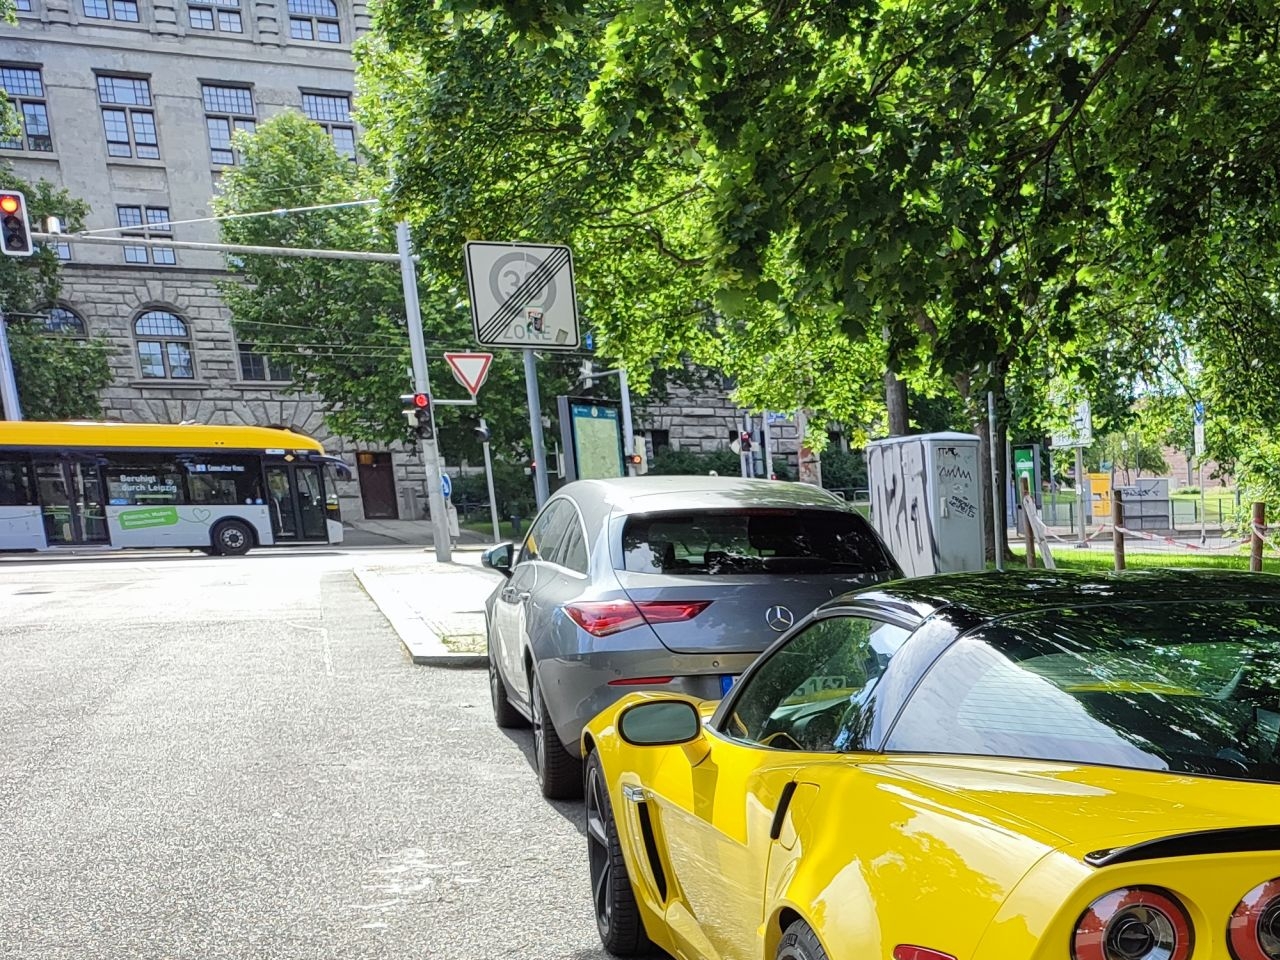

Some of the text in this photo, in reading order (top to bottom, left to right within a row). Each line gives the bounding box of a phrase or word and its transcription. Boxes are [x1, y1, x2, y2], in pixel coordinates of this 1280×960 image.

[119, 474, 156, 484] Beruhigt
[121, 483, 178, 493] durch Leipzig
